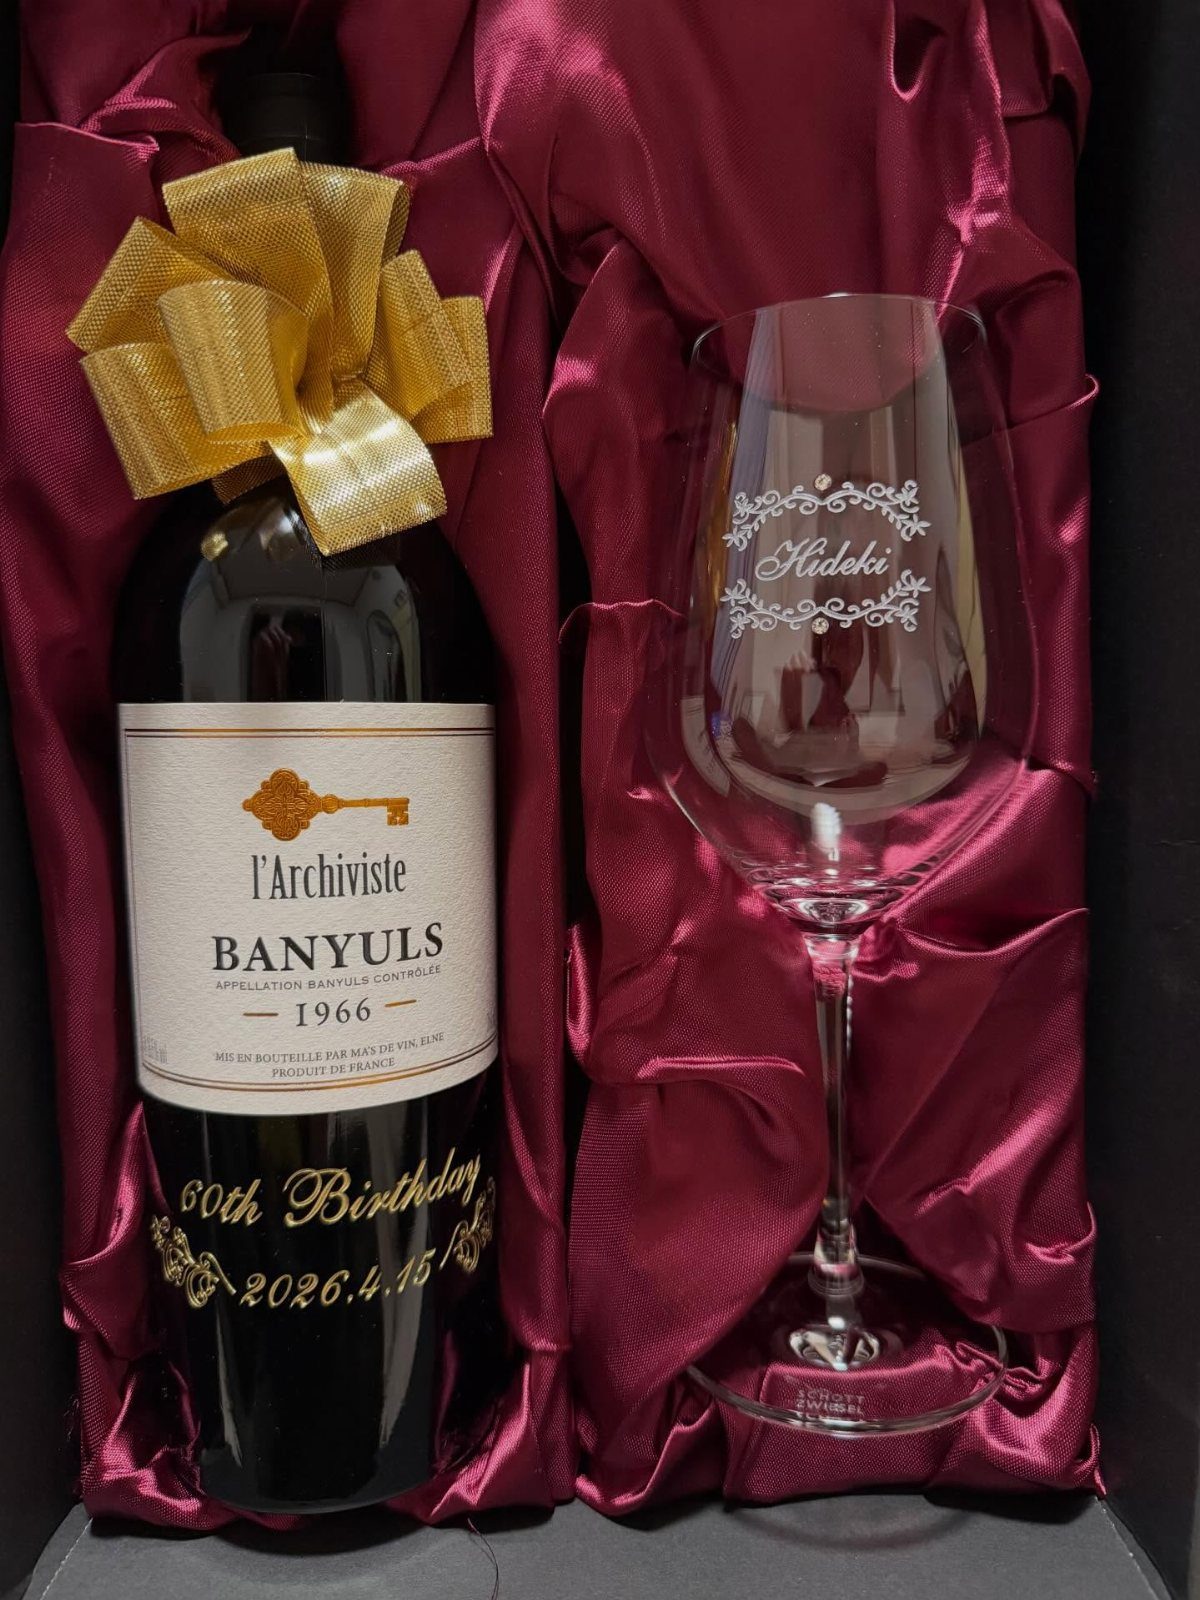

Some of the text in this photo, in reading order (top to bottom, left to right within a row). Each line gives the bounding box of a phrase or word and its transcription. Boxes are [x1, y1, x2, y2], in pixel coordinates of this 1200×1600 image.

[755, 537, 892, 581] Hideki
[211, 922, 444, 973] BANYULS
[215, 964, 441, 991] APPELLATION BANYULS CONTRÔLÉE
[295, 997, 371, 1027] 1966
[215, 1052, 236, 1063] MIS
[236, 1053, 253, 1063] EN
[254, 1051, 323, 1064] BOUTEILLE
[325, 1049, 348, 1061] PAR
[379, 1042, 395, 1055] DE
[420, 1031, 445, 1047] ELNE
[271, 1058, 396, 1078] PRODUIT DE FRANCE
[180, 1147, 481, 1228] 60th Birthday
[239, 1248, 437, 1309] 2026.4.15
